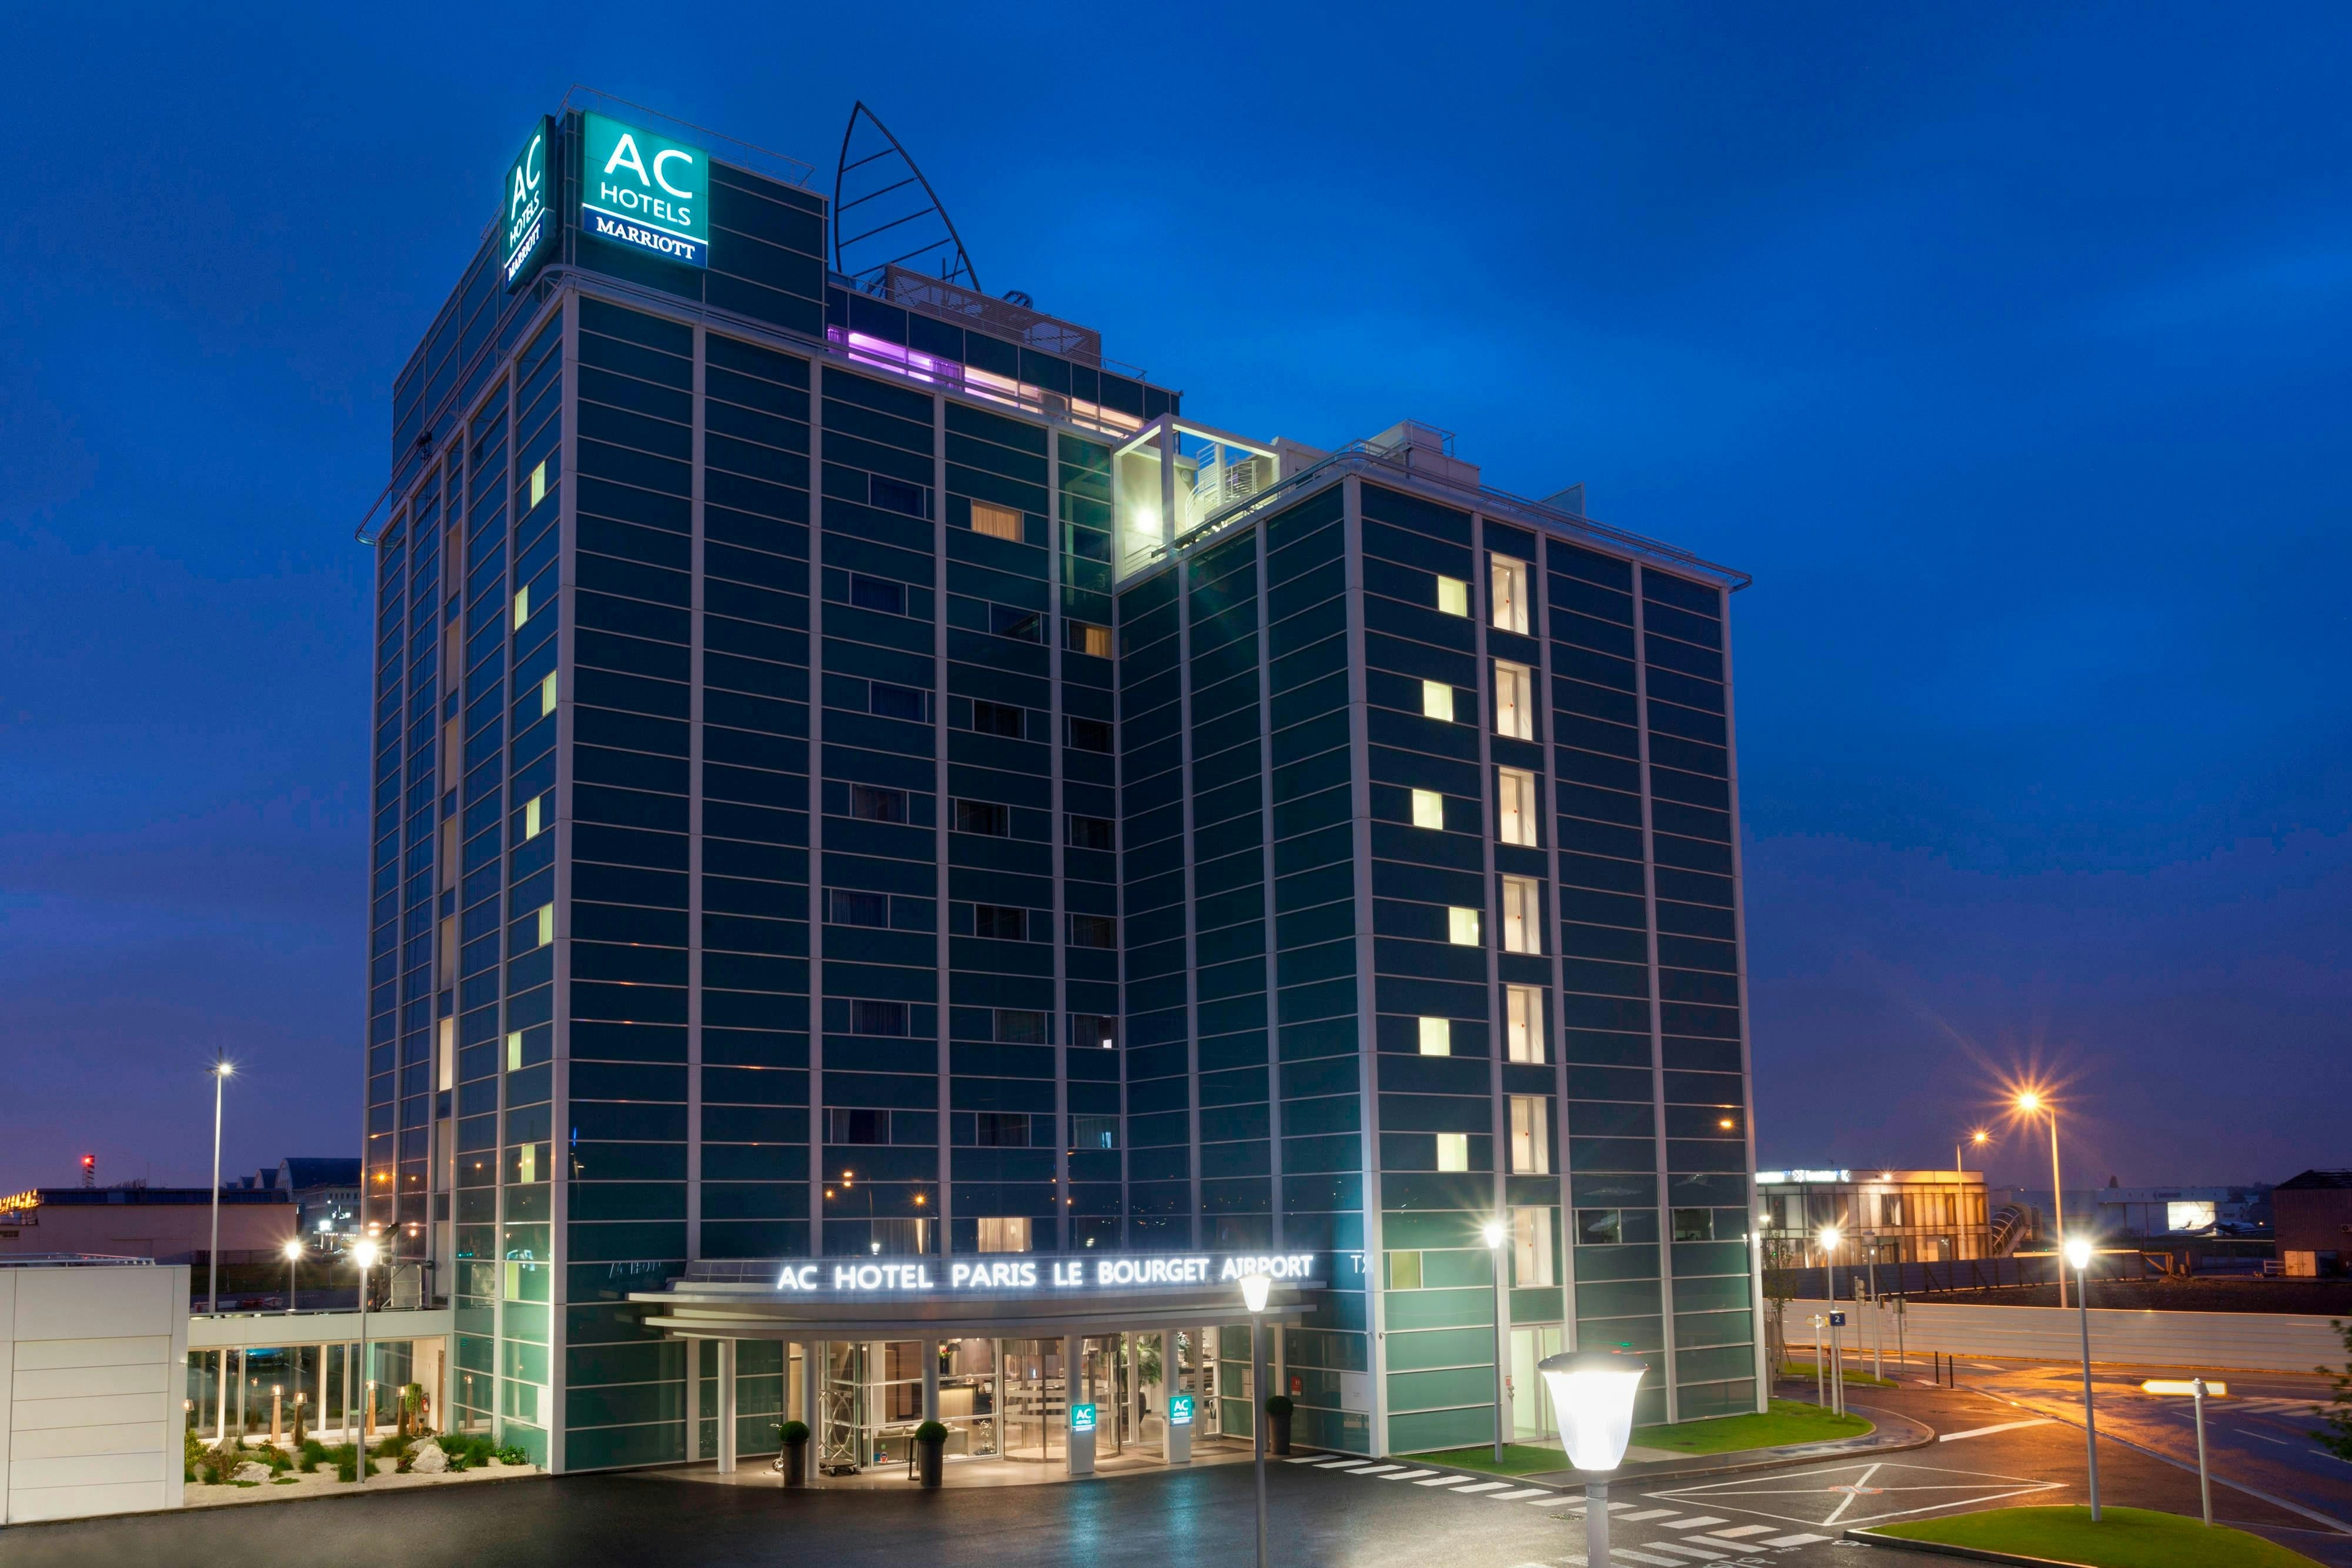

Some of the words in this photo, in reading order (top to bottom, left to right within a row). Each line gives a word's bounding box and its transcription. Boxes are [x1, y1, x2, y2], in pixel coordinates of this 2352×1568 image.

[511, 135, 541, 220] AC
[604, 133, 693, 199] AC
[509, 190, 540, 248] HOTELS
[601, 182, 691, 226] HOTELS
[507, 223, 540, 281] MARRIOTT
[596, 216, 695, 259] MARRIOTT
[777, 1266, 817, 1290] AC
[835, 1265, 934, 1289] HOTEL
[952, 1263, 1037, 1288] PARIS
[1054, 1262, 1083, 1286] LE
[1098, 1258, 1210, 1285] BOURGET
[1221, 1255, 1314, 1280] AIRPORT
[1076, 1408, 1092, 1420] AC
[1174, 1399, 1189, 1412] AC
